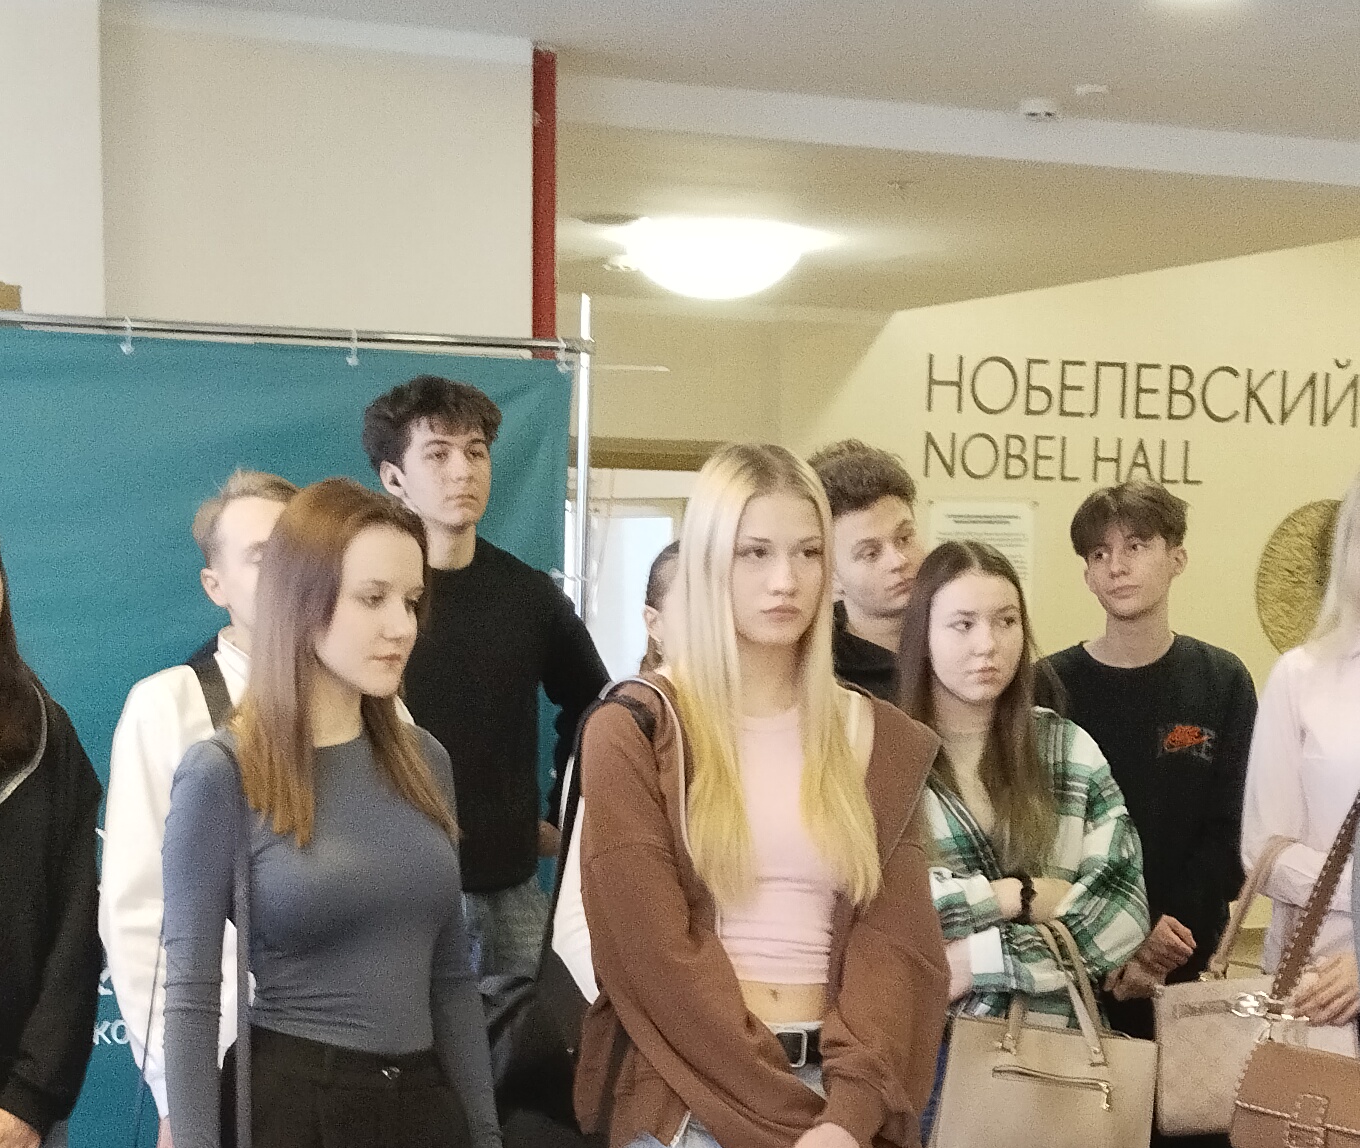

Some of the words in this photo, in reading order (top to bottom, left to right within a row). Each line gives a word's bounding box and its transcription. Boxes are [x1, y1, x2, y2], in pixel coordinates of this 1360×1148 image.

[925, 353, 1360, 428] НОБЕЛЕВСКИЙ
[923, 430, 1081, 481] NOBEL
[1092, 436, 1203, 485] HALL
